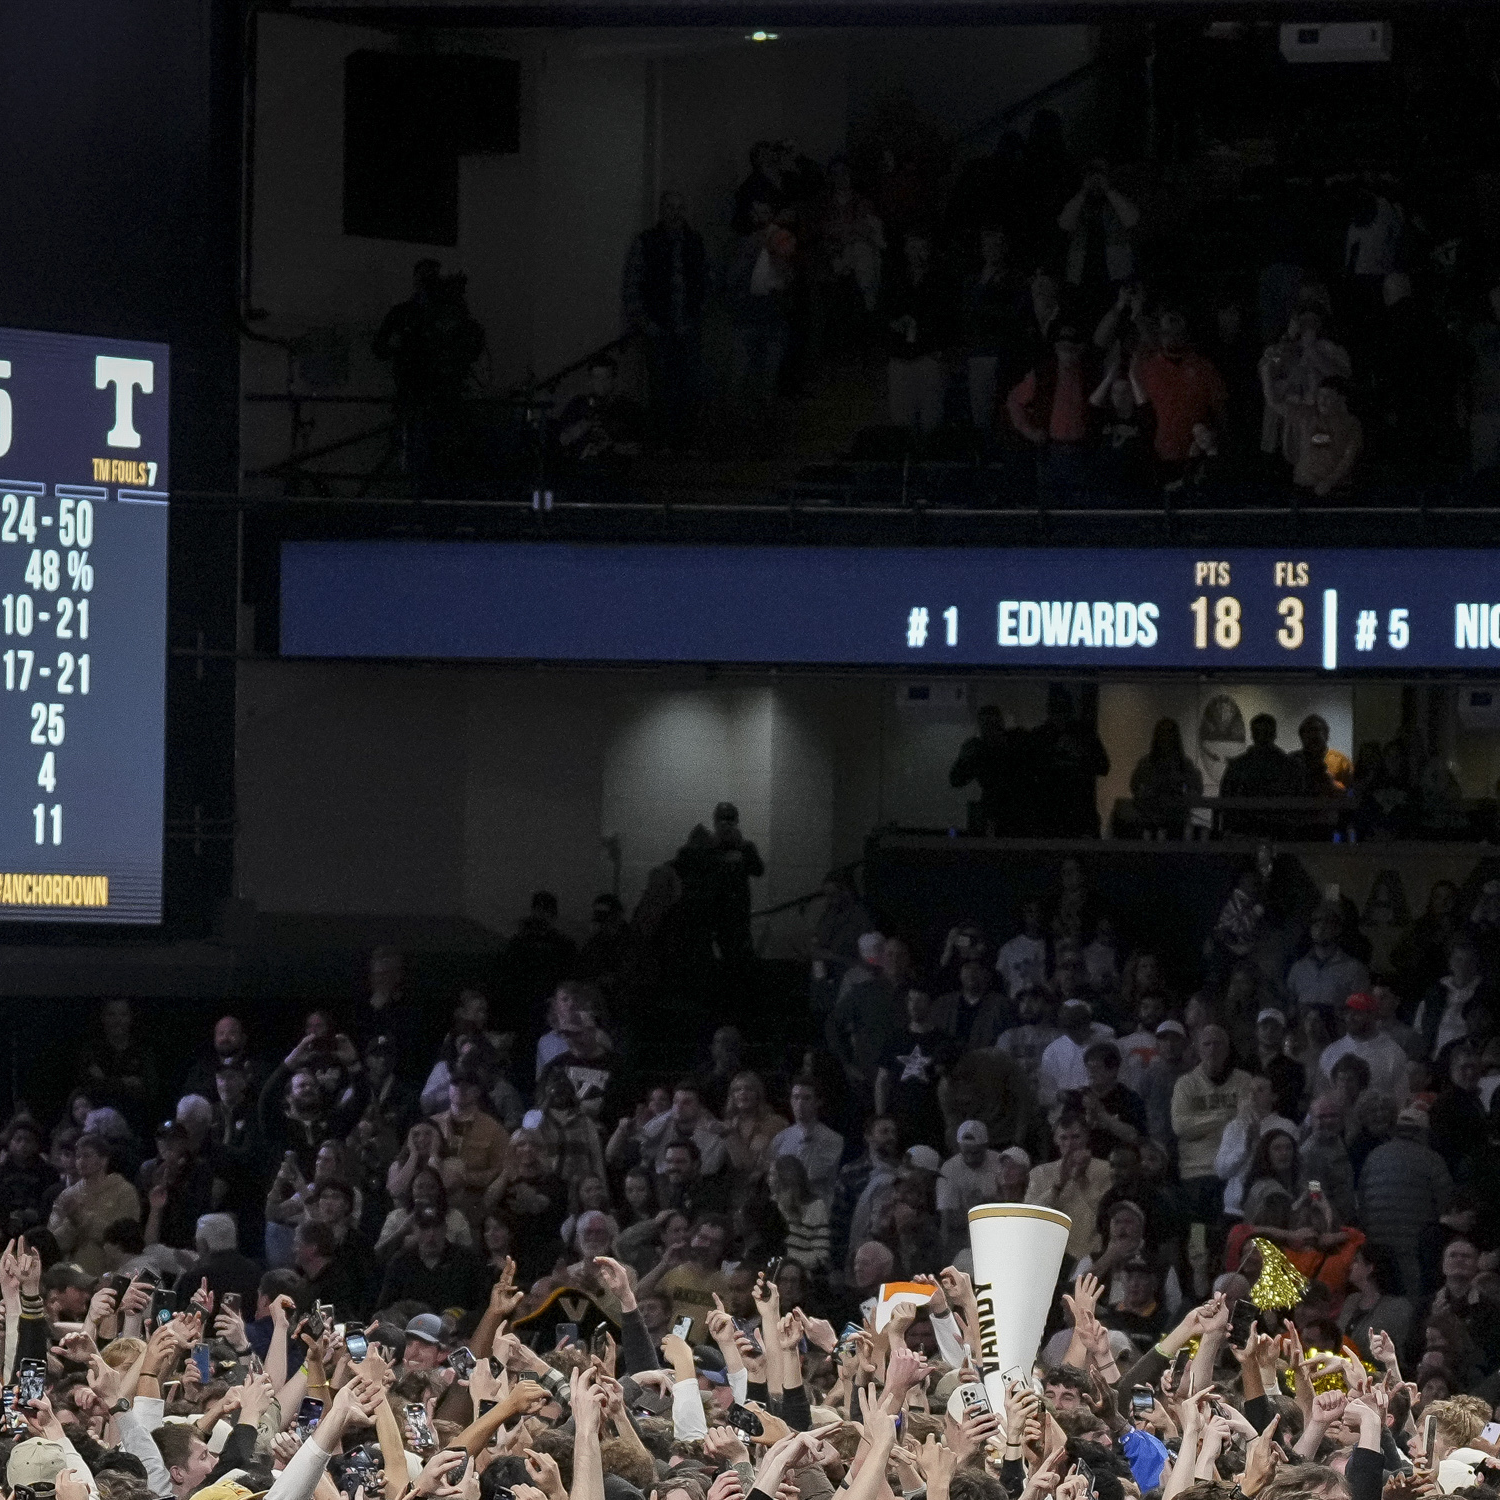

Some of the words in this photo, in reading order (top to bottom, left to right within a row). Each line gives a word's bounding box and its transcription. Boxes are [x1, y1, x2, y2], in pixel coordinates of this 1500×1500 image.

[95, 355, 154, 449] T
[92, 459, 111, 482] TM
[111, 460, 147, 485] FOULS
[147, 461, 158, 487] 7
[24, 549, 60, 592] 48
[66, 551, 94, 593] %
[1195, 561, 1230, 586] PTS
[1275, 561, 1309, 587] FLS
[997, 600, 1160, 648] EDWARDS
[1190, 596, 1241, 649] 18
[1278, 596, 1304, 649] 3
[30, 702, 66, 747] 25
[37, 751, 57, 794] 4
[32, 803, 63, 846] 11
[975, 1281, 1001, 1379] VANDY
